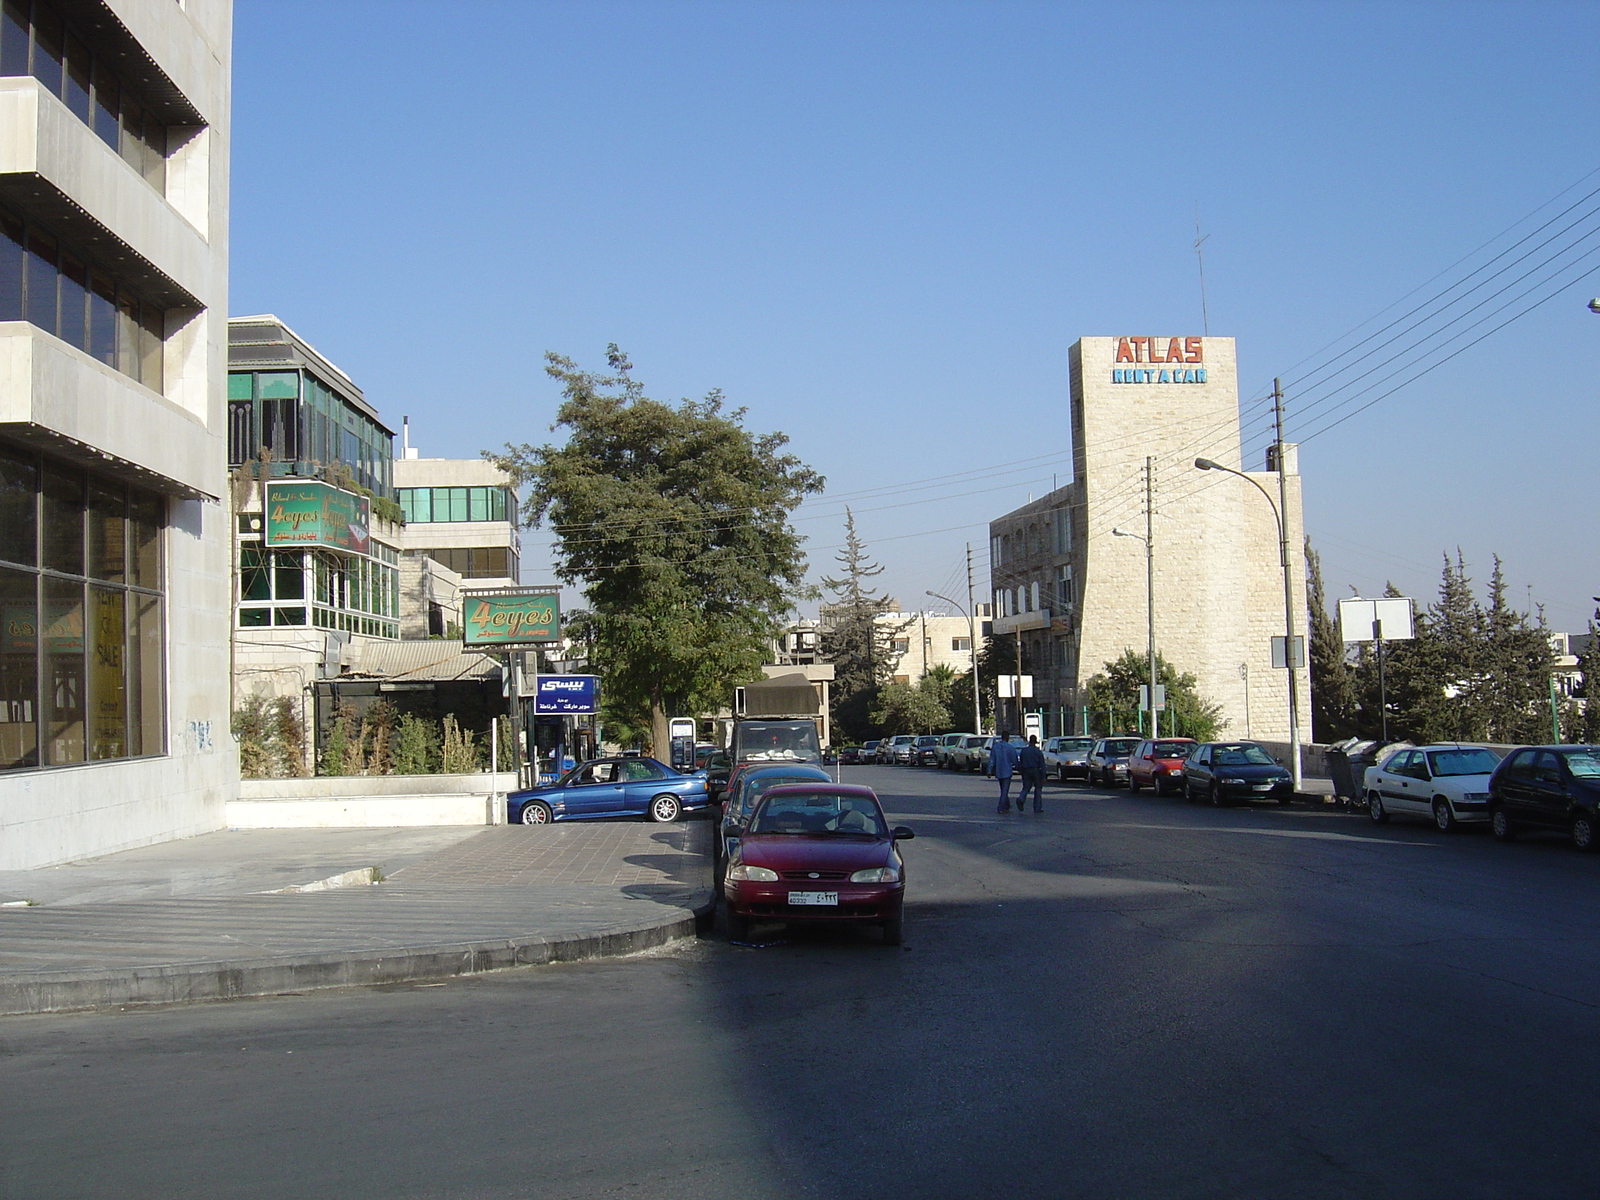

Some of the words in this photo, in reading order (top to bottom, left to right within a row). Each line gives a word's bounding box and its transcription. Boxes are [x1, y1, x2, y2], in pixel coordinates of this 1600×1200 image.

[1116, 337, 1202, 363] ATLAS
[1112, 369, 1155, 384] RENT
[1158, 369, 1170, 384] A
[1173, 369, 1206, 384] CAR
[271, 505, 318, 531] 4eyes
[470, 600, 553, 637] 4eyes
